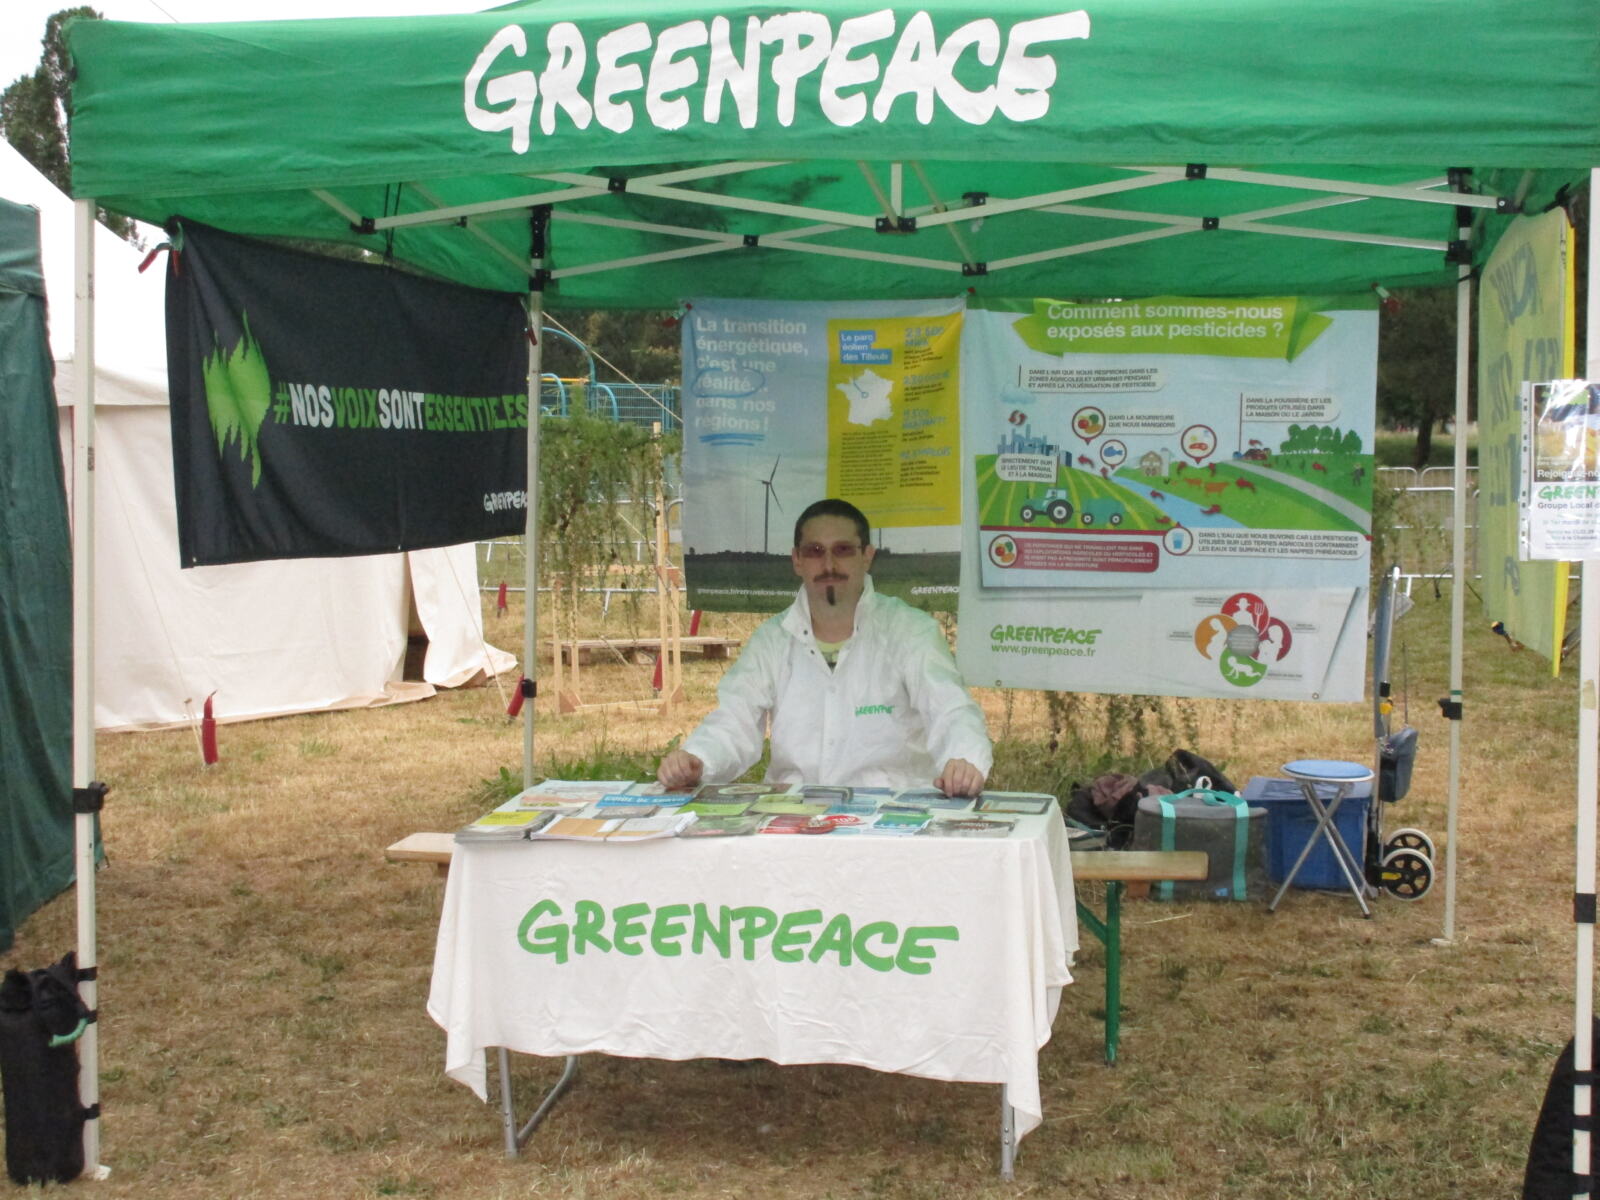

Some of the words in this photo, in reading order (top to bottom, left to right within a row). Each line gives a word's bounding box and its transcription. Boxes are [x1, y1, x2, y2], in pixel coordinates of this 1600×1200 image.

[464, 10, 1091, 154] GREENPEACE
[1047, 306, 1141, 320] Comment
[1146, 305, 1283, 320] sommes-nous
[696, 317, 717, 332] La
[723, 319, 807, 334] transition
[1047, 321, 1125, 341] exposés
[1131, 324, 1165, 336] aux
[1168, 322, 1266, 341] pesticides
[1272, 322, 1284, 336] ?
[695, 336, 809, 356] énergétique,
[854, 335, 875, 344] parc
[697, 355, 737, 372] c'est
[742, 360, 777, 372] une
[695, 396, 737, 409] dans
[743, 400, 777, 412] nos
[1538, 502, 1568, 511] Groupe
[990, 624, 1102, 644] GREENPEACE
[991, 645, 1096, 658] www.greenpeace.fr
[517, 899, 959, 975] GREENPEACE
